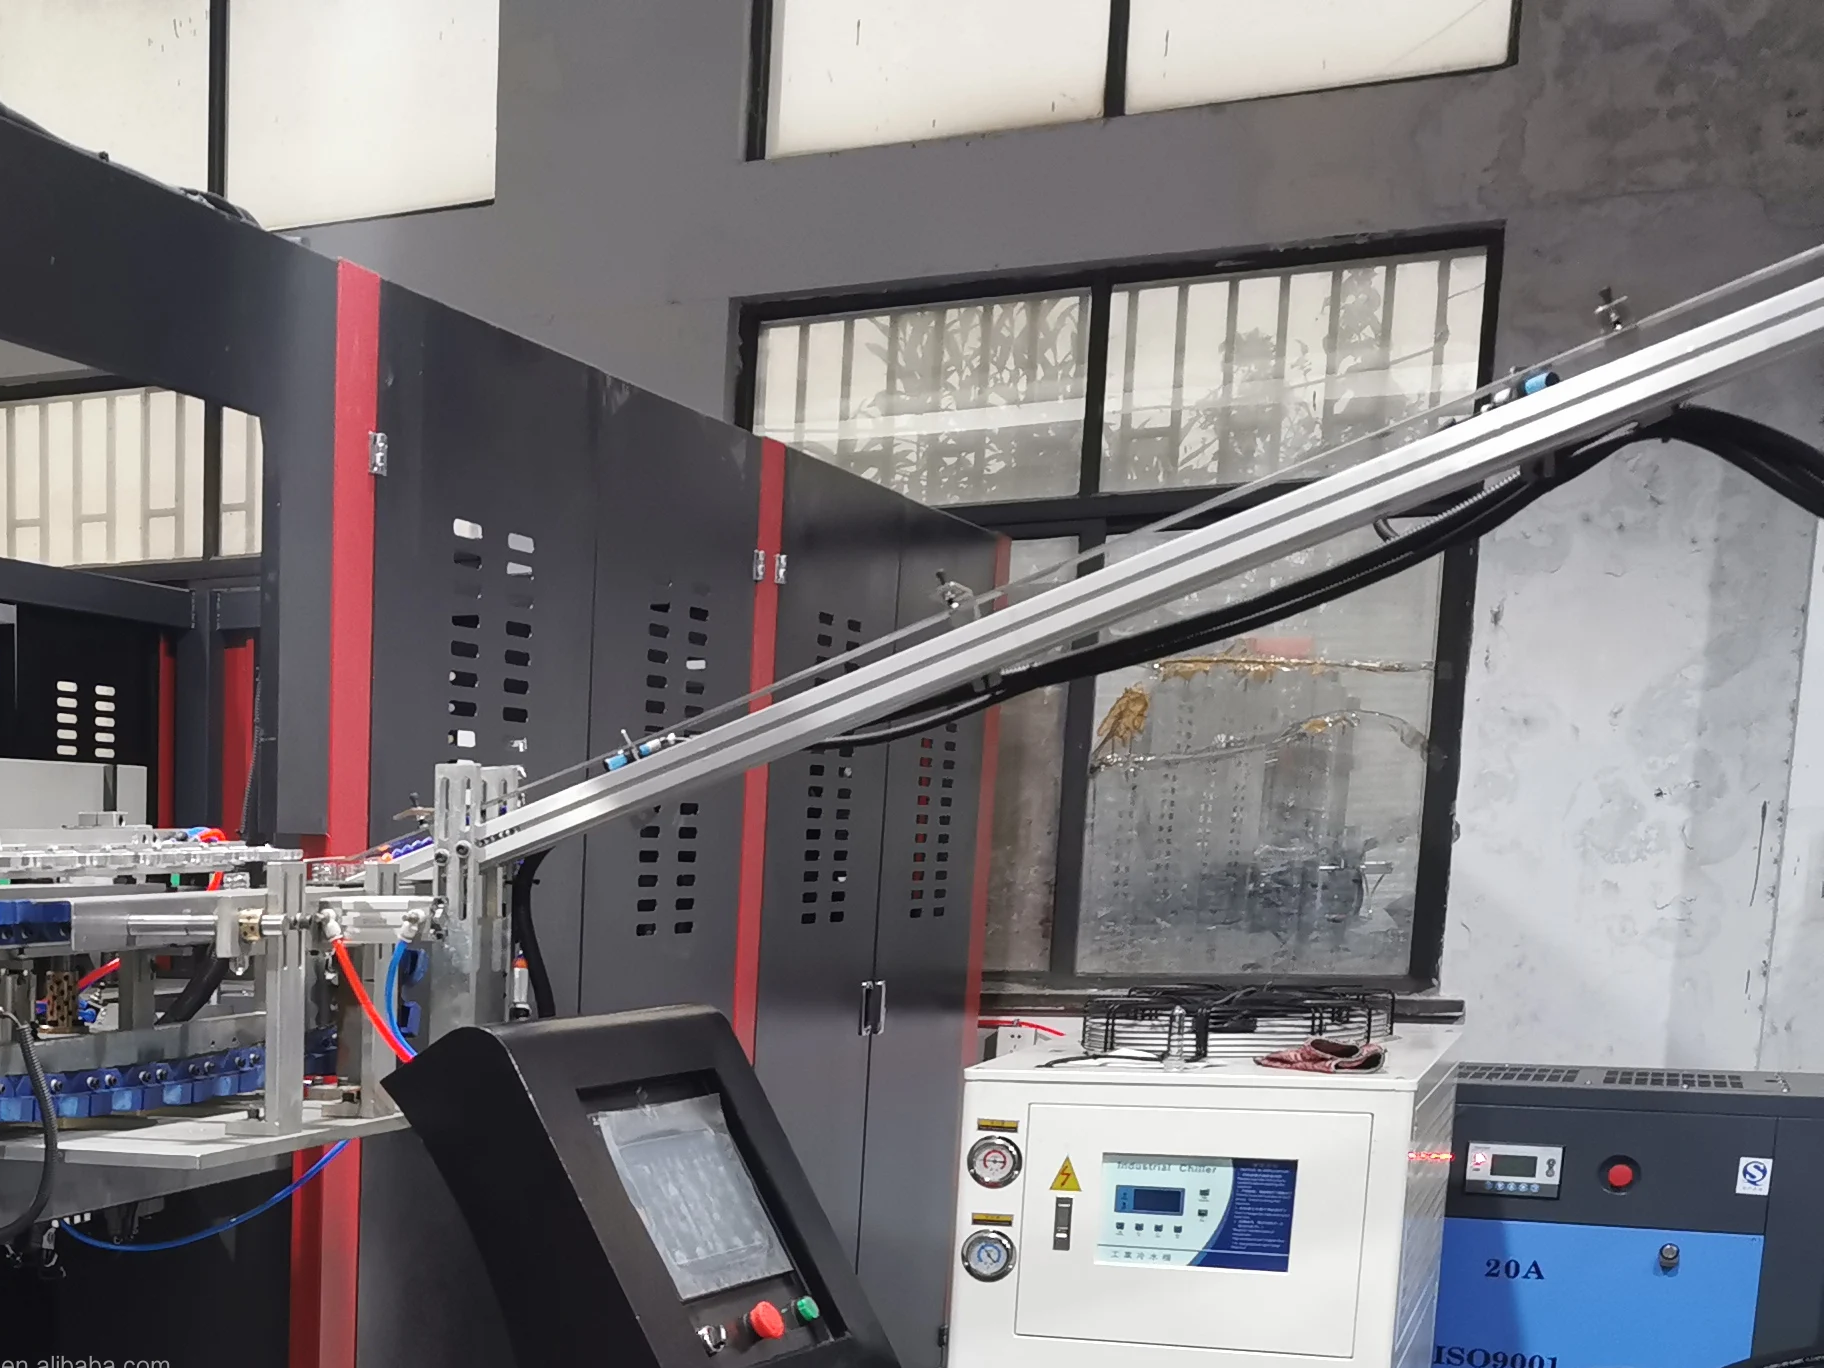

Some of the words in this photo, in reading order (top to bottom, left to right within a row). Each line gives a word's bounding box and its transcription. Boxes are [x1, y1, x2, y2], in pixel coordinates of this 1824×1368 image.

[1116, 1161, 1171, 1172] Industrial
[1179, 1164, 1217, 1174] Chiller
[1484, 1258, 1545, 1280] 20A
